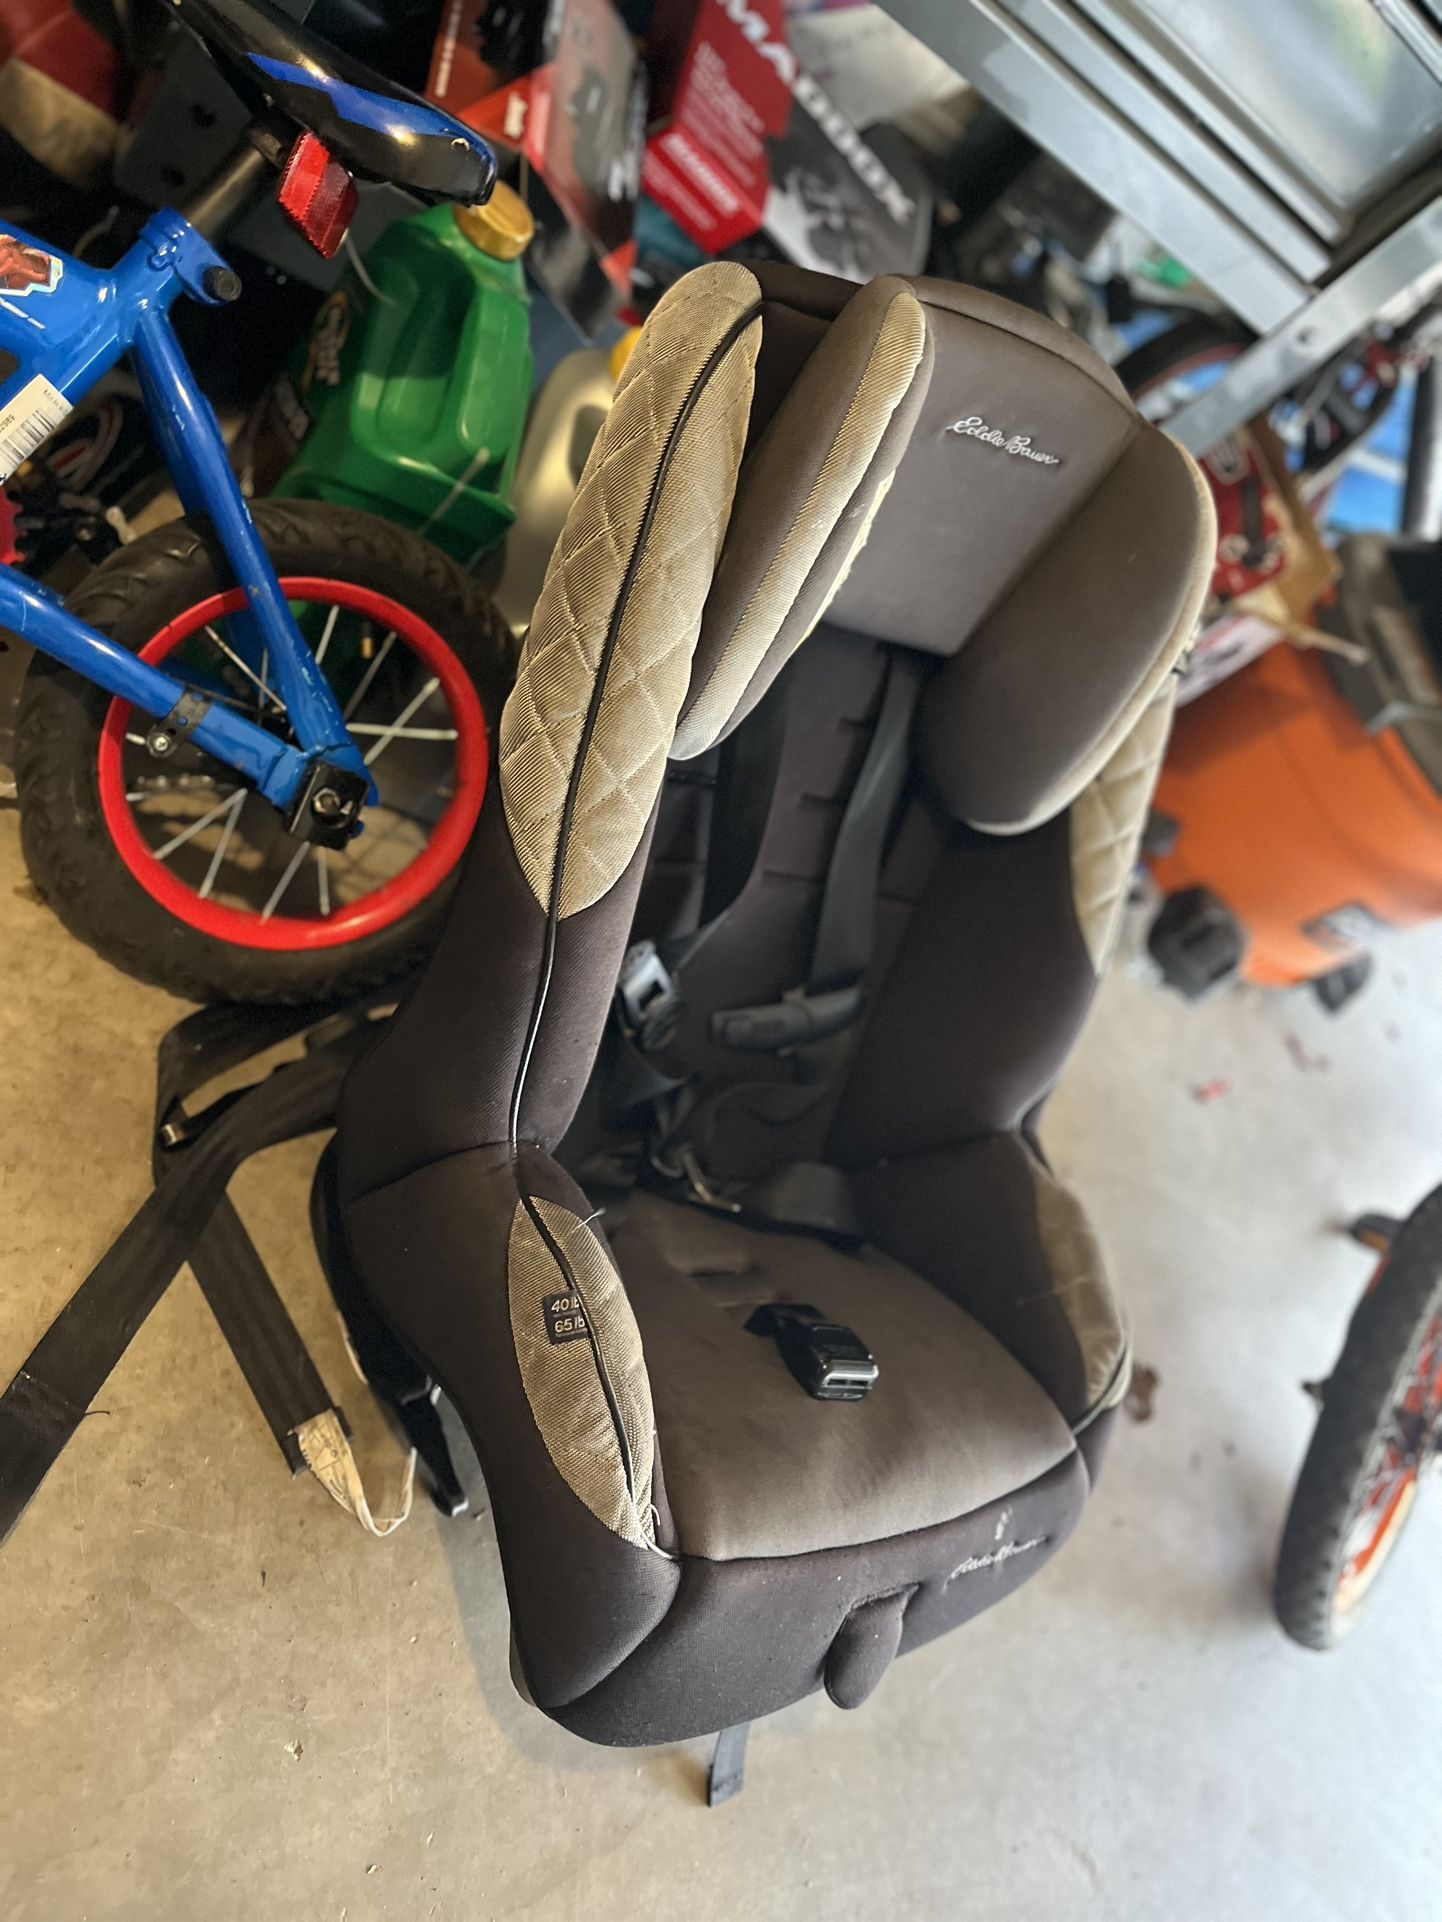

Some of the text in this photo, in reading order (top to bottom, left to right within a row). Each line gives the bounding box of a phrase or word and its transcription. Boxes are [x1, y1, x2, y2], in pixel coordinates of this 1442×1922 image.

[945, 416, 1060, 464] Eddie Bauer
[551, 1298, 570, 1312] 40
[554, 1318, 573, 1333] 65
